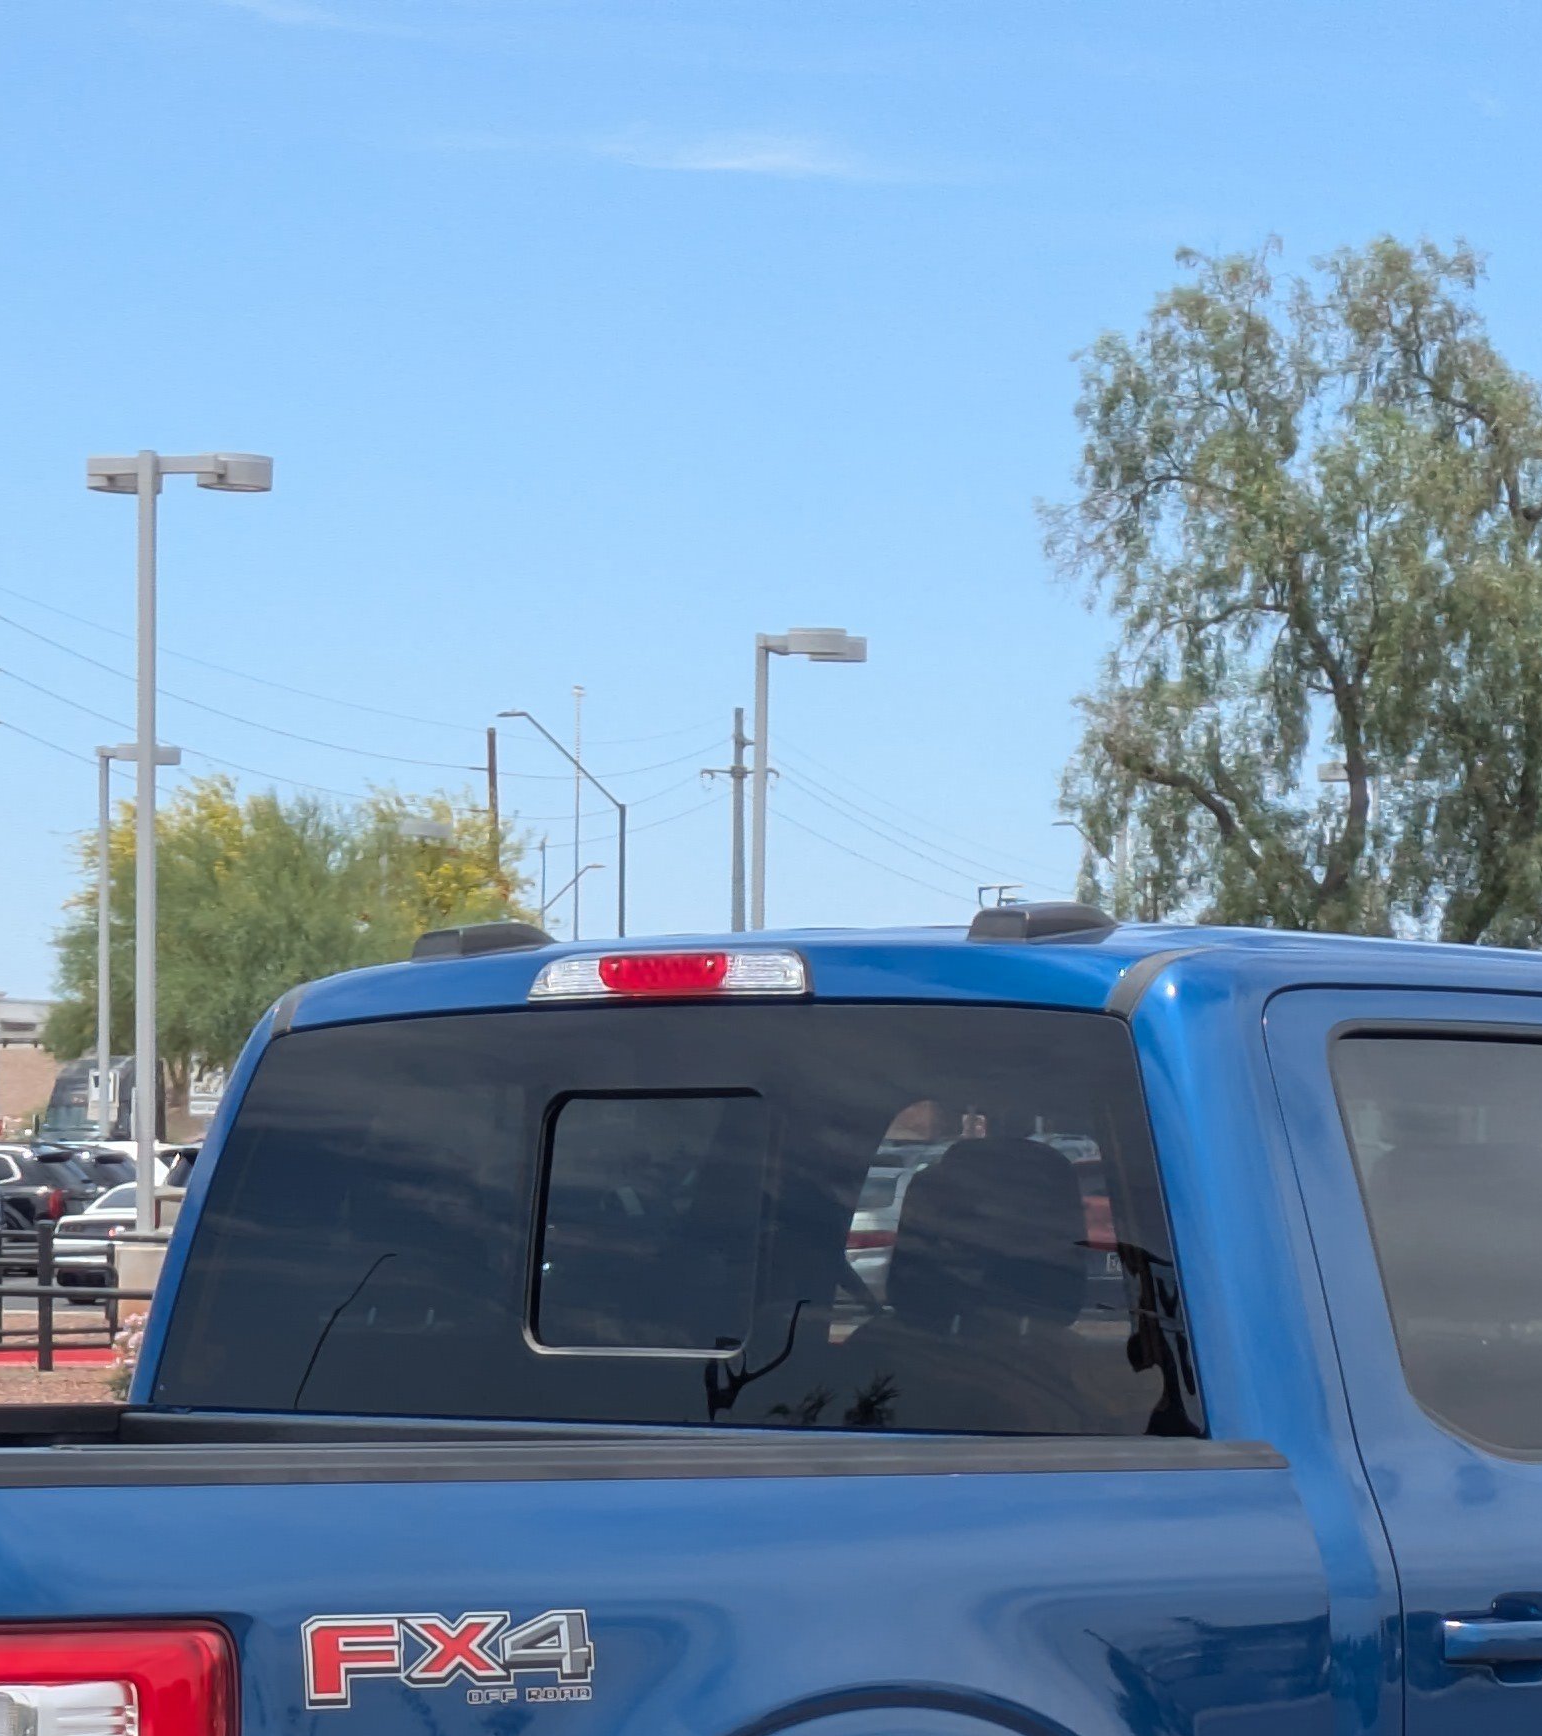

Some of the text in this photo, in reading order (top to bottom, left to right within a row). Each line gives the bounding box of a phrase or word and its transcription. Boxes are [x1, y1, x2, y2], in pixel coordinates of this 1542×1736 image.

[300, 1607, 595, 1710] FX4
[465, 1685, 592, 1706] OFF ROAD
